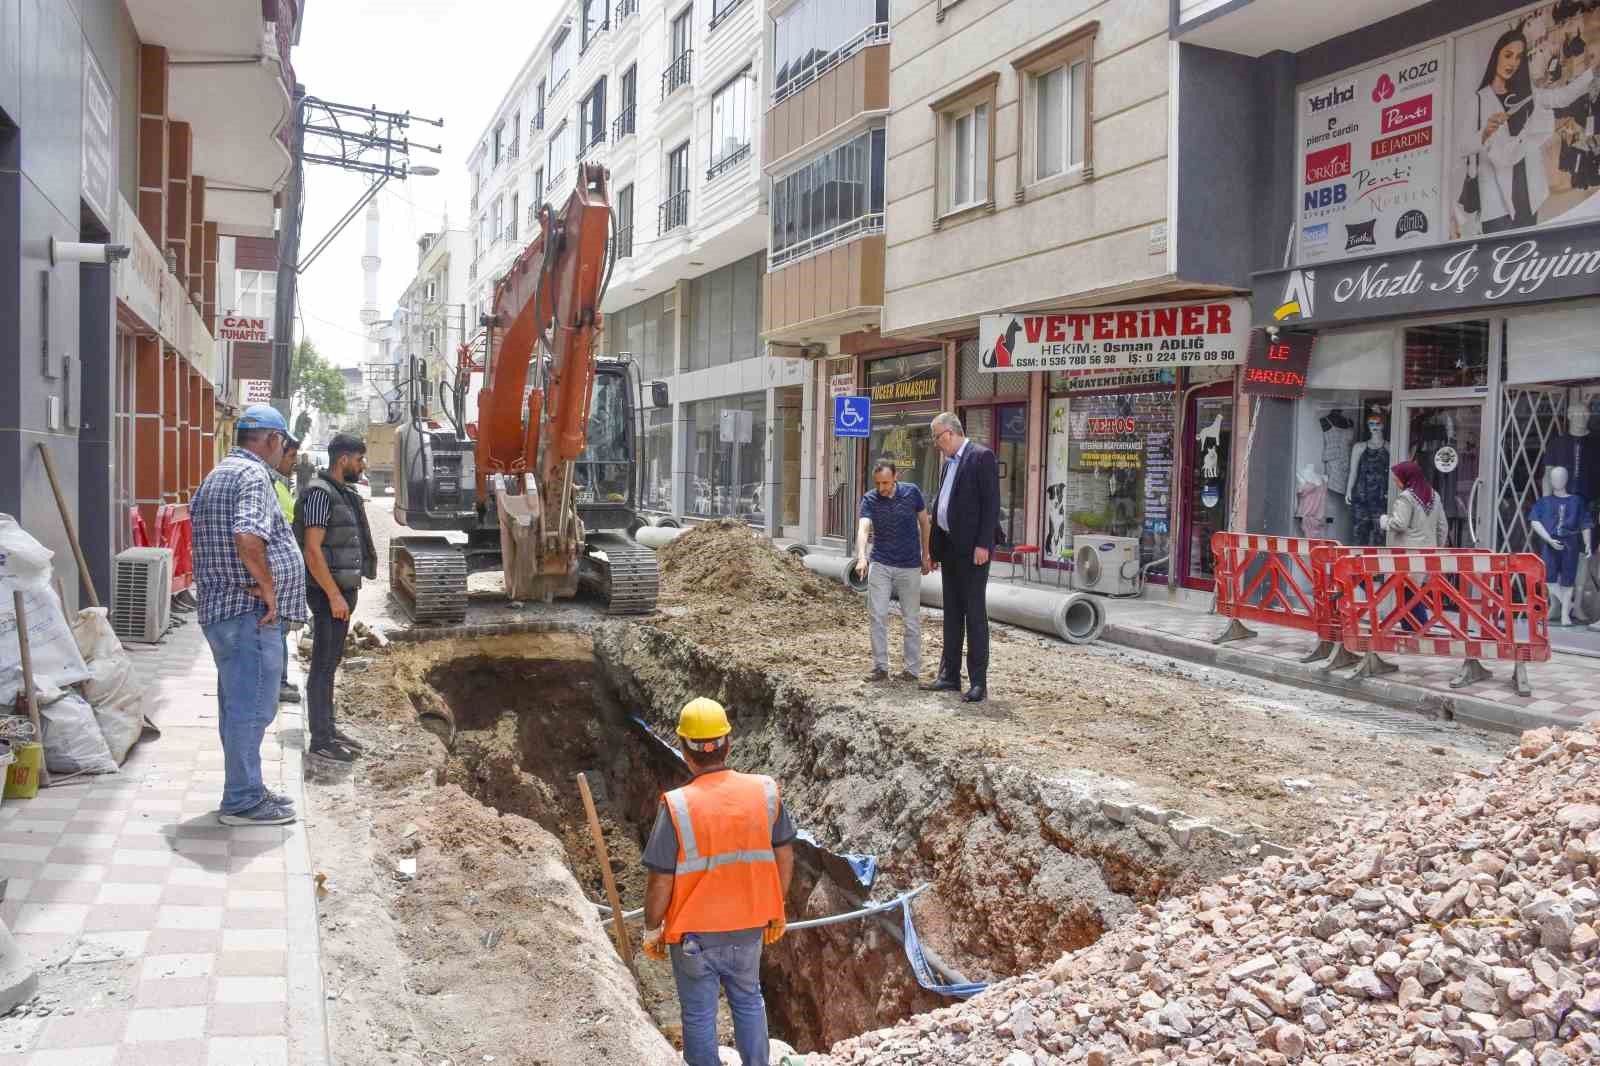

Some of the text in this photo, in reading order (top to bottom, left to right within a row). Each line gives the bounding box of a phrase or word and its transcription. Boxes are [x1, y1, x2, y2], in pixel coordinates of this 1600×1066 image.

[1304, 183, 1347, 211] NBB
[1334, 259, 1423, 303] Nazlı
[1484, 240, 1600, 299] Giyim
[223, 317, 264, 330] CAN
[1103, 341, 1153, 353] Osman
[1268, 345, 1289, 360] LE
[1041, 358, 1046, 366] 0
[1147, 353, 1153, 362] 0
[1157, 352, 1176, 361] 224
